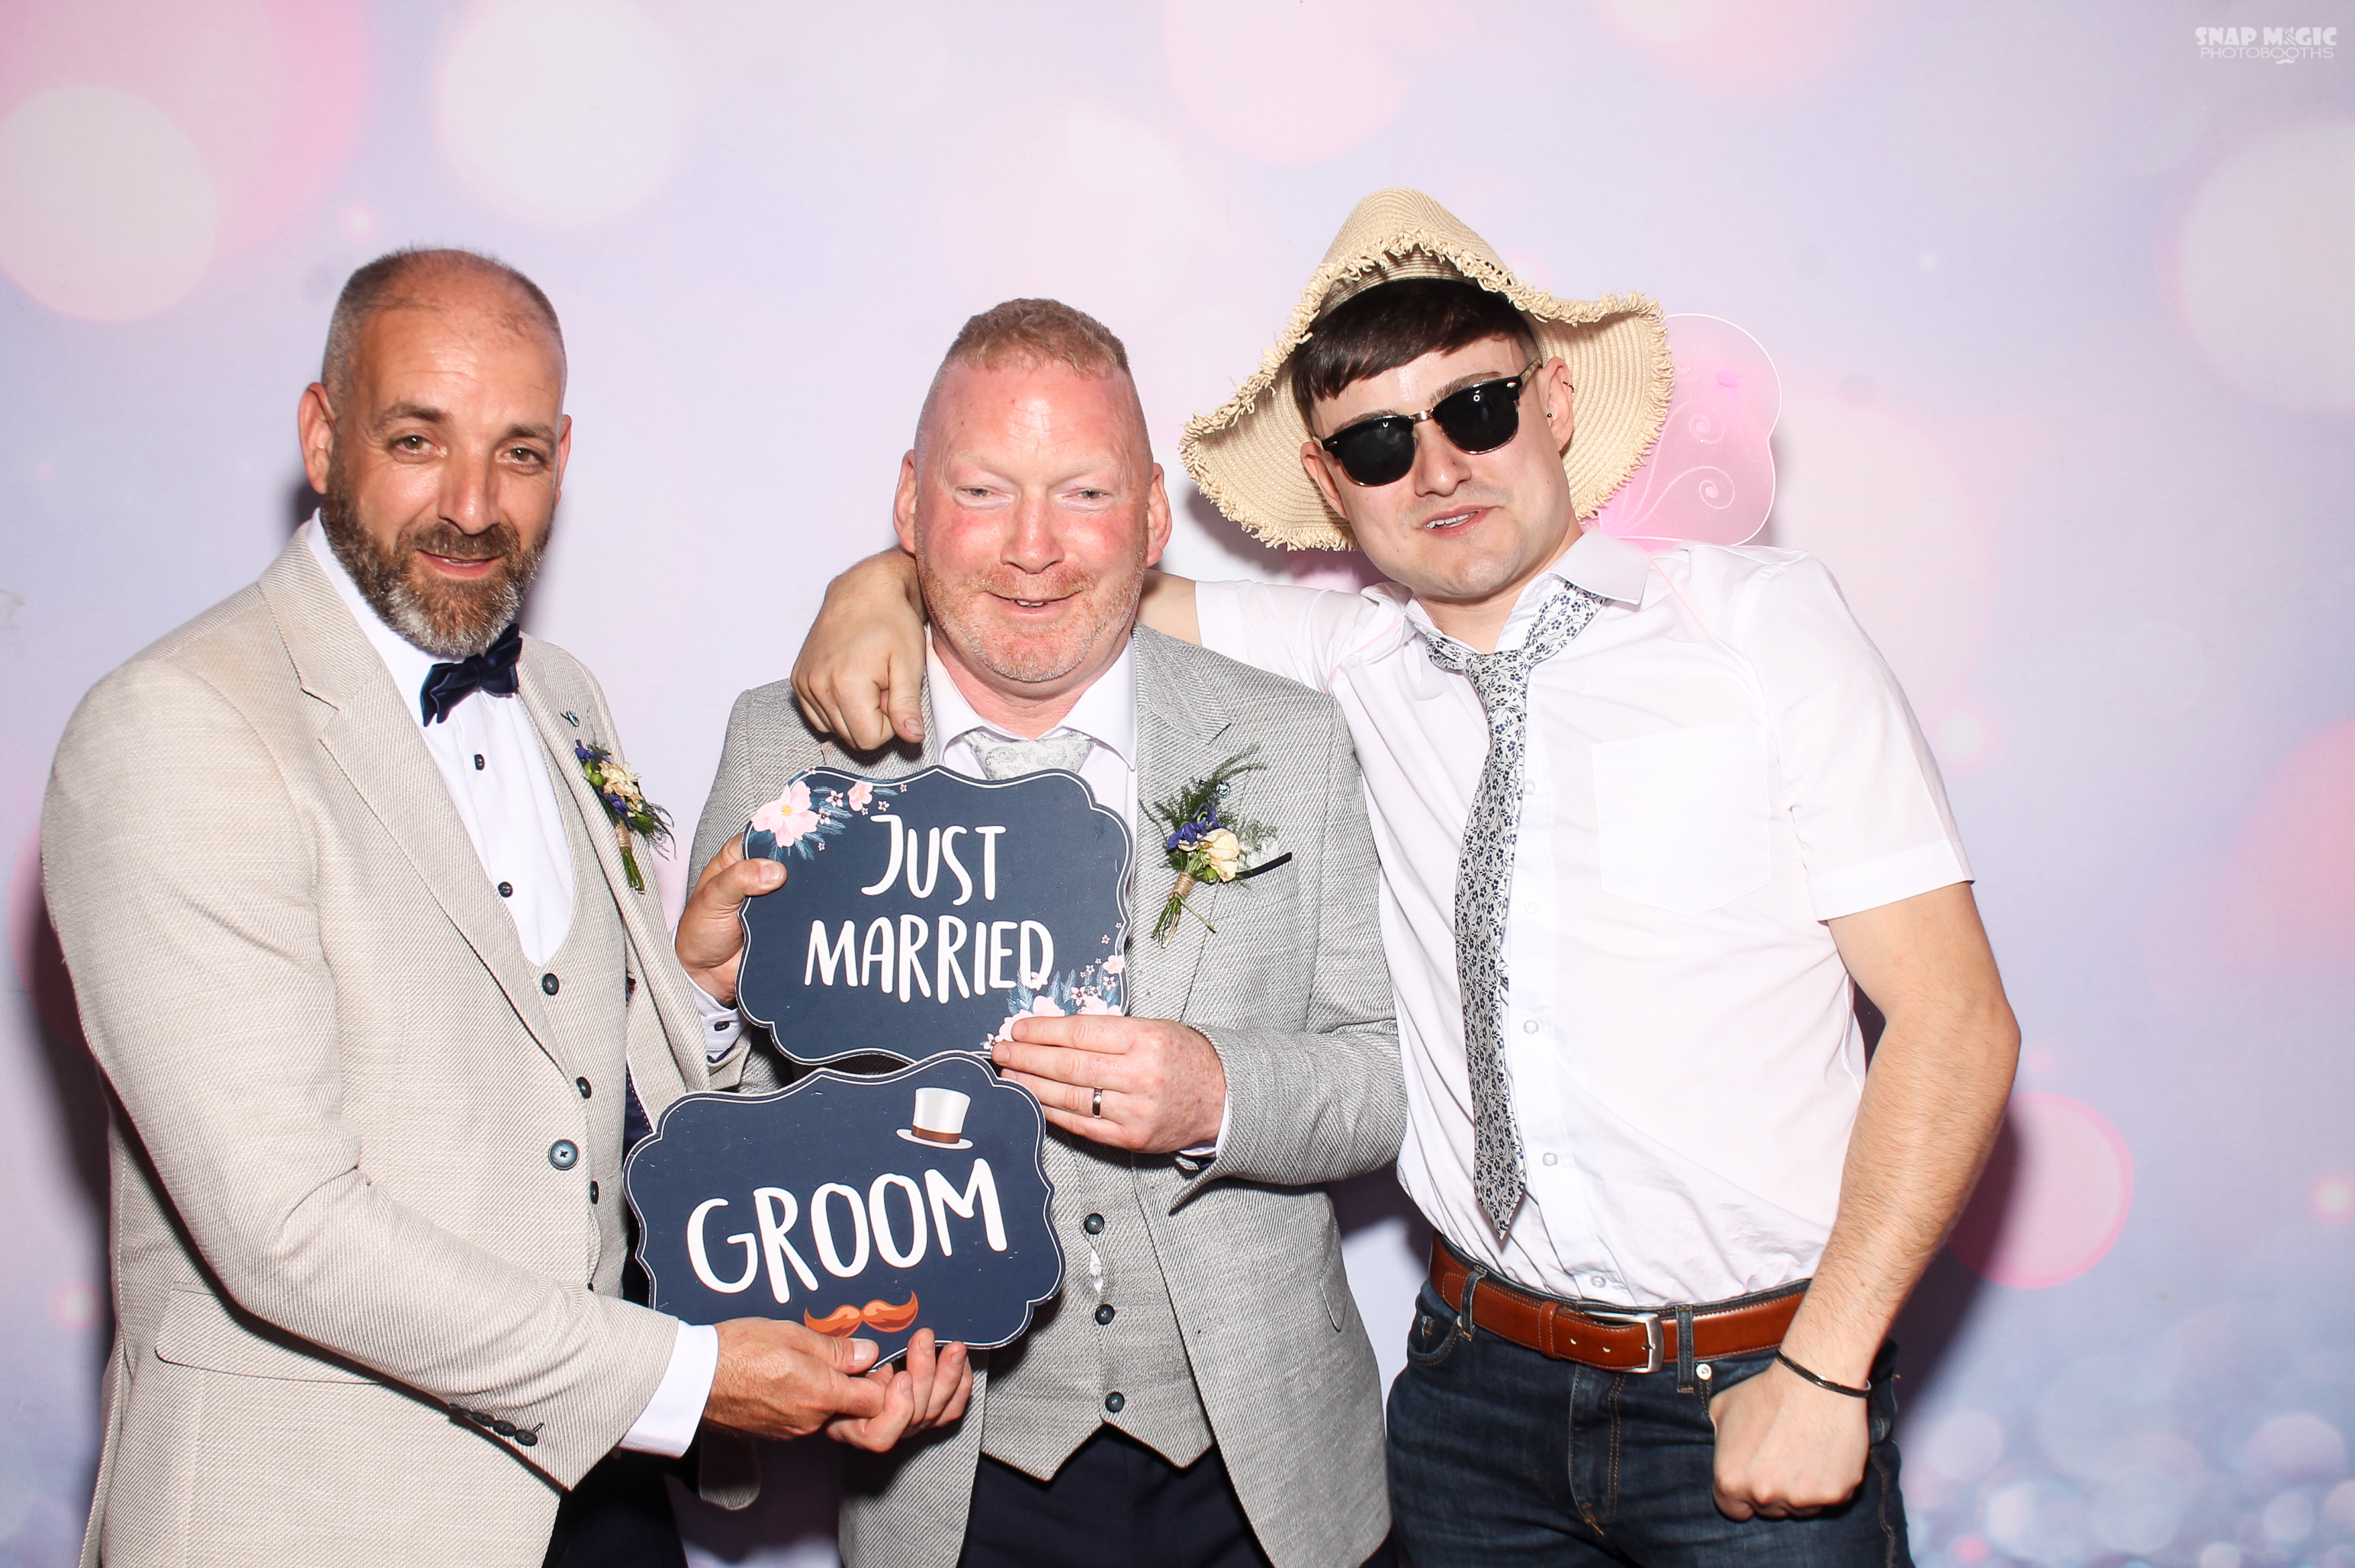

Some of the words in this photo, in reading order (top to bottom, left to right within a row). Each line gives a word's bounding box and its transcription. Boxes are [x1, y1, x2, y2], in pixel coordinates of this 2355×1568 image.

[861, 814, 1006, 905] JUST
[804, 914, 1054, 1004] MARRIED
[686, 1158, 1007, 1303] GROOM
